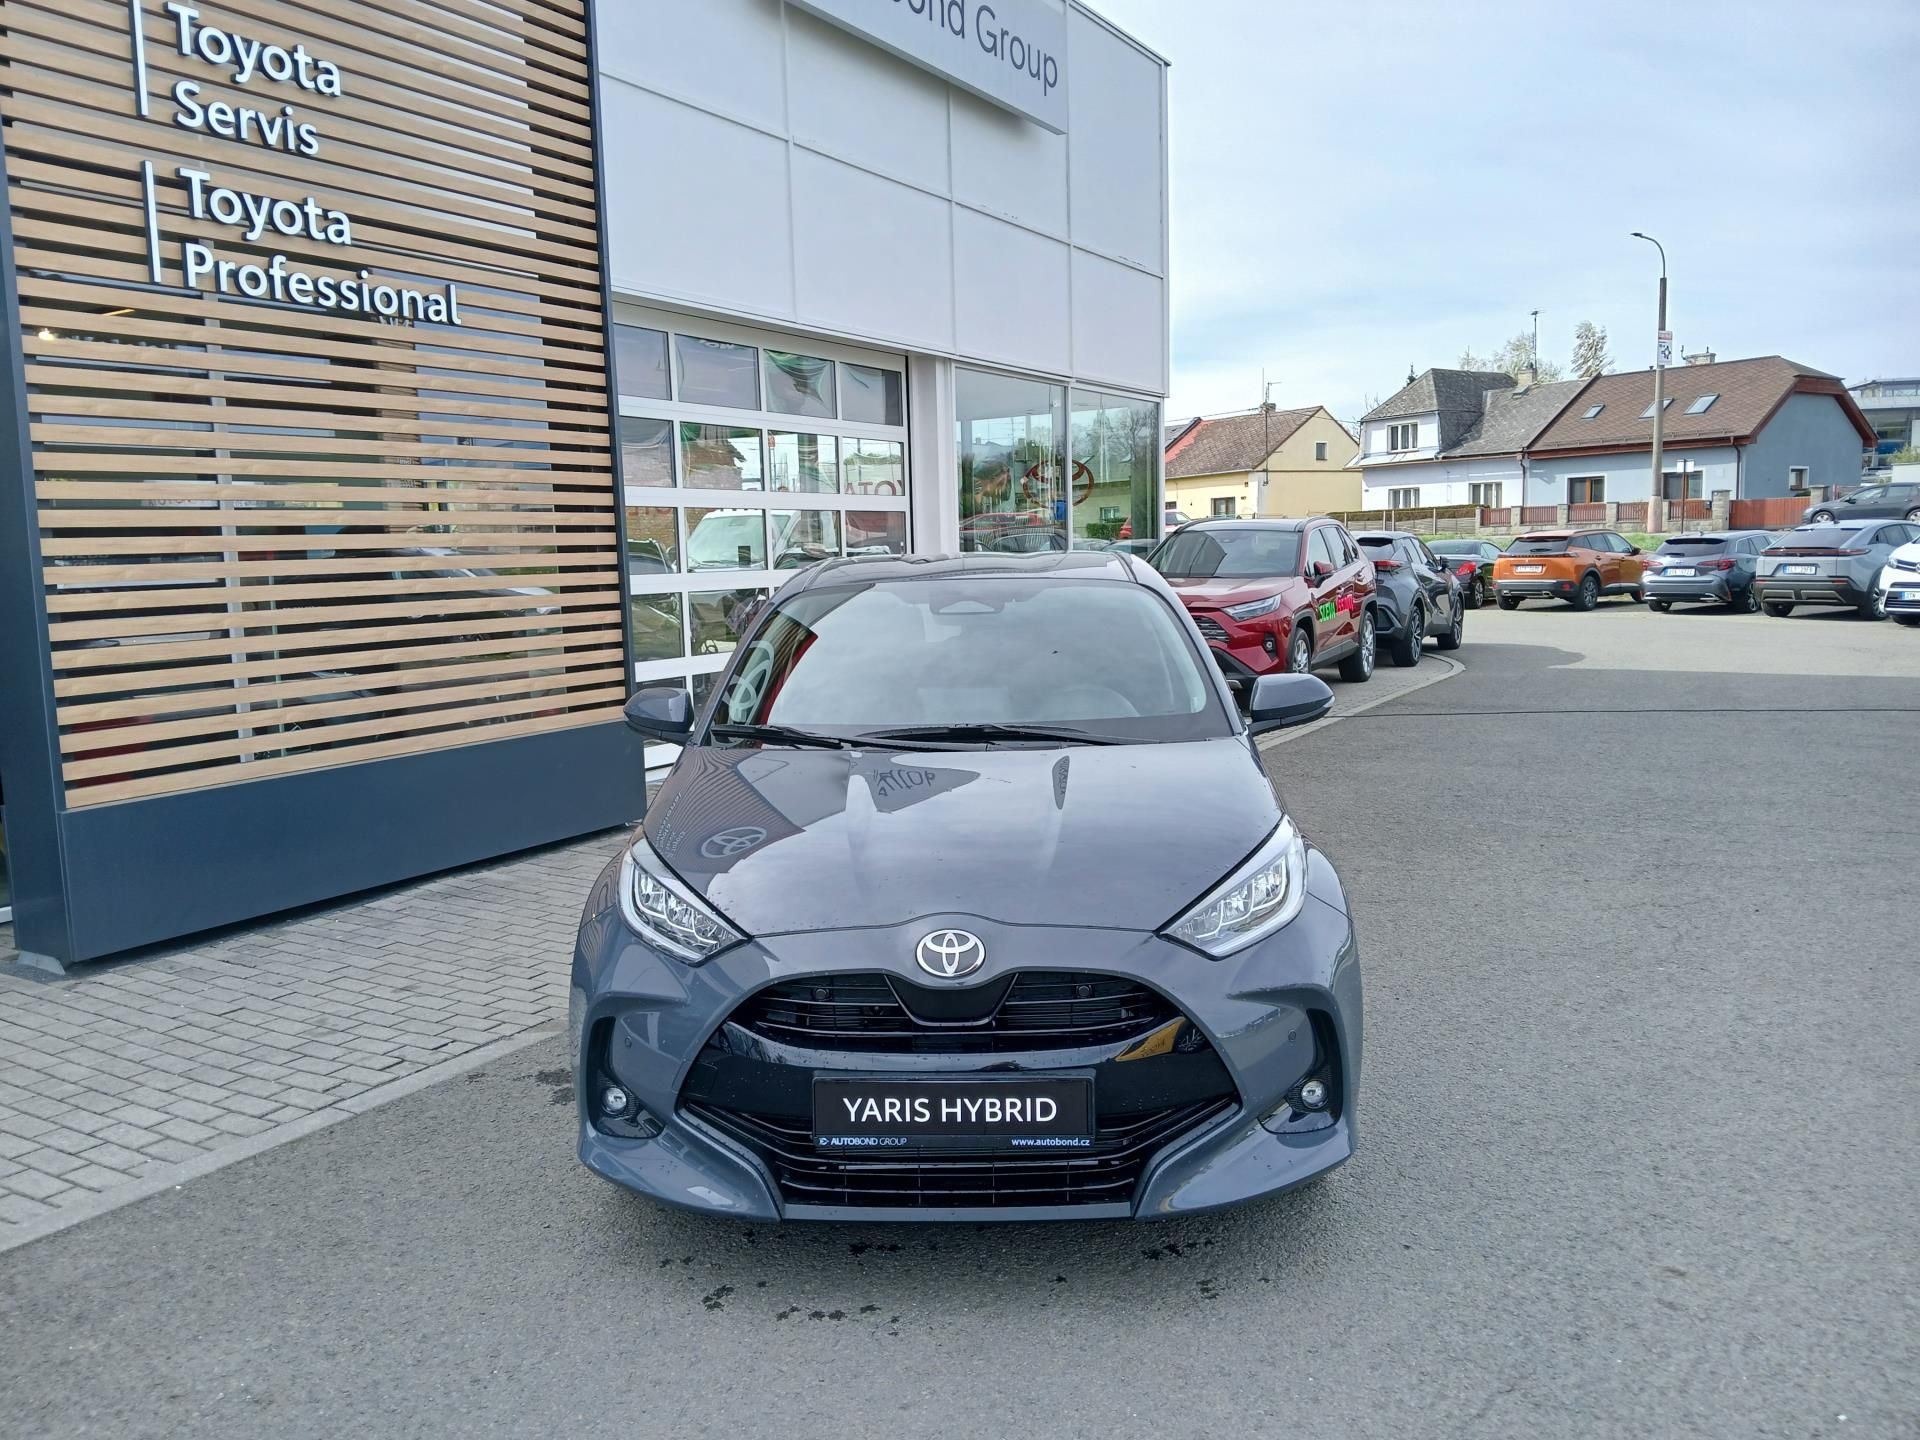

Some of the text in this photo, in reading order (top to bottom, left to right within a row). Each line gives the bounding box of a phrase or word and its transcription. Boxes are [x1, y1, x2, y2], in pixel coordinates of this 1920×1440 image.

[166, 1, 342, 97] Toyota
[976, 5, 1058, 96] Group
[174, 80, 319, 156] Servis
[178, 167, 352, 245] Toyota
[184, 243, 461, 325] Professional
[830, 1138, 907, 1146] AUTOBOND GROUP
[843, 1098, 1057, 1122] YARIS HYBRID
[1011, 1137, 1091, 1147] www.autobond.cz
